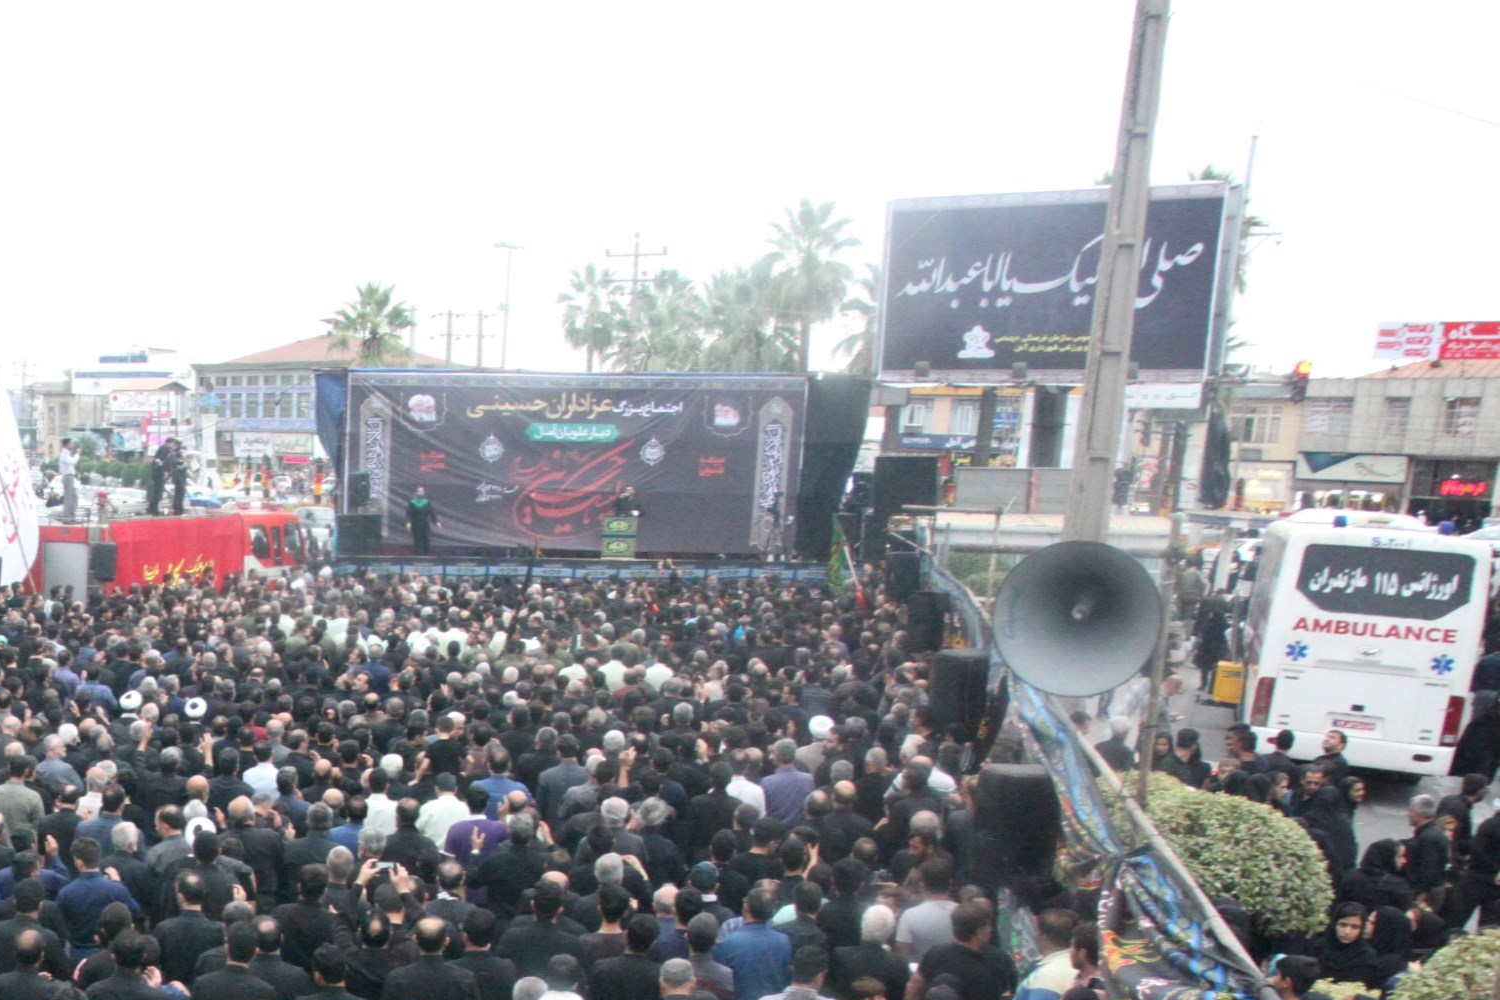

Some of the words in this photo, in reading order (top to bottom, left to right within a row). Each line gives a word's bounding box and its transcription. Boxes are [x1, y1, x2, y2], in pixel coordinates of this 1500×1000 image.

[466, 394, 548, 418] حسینی
[545, 392, 612, 419] عزاداران
[612, 400, 646, 417] بزرگ
[643, 401, 683, 417] اجتماع
[1308, 565, 1368, 594] مازندران
[1401, 571, 1460, 600] اورژانس
[1292, 616, 1458, 644] AMBULANCE
